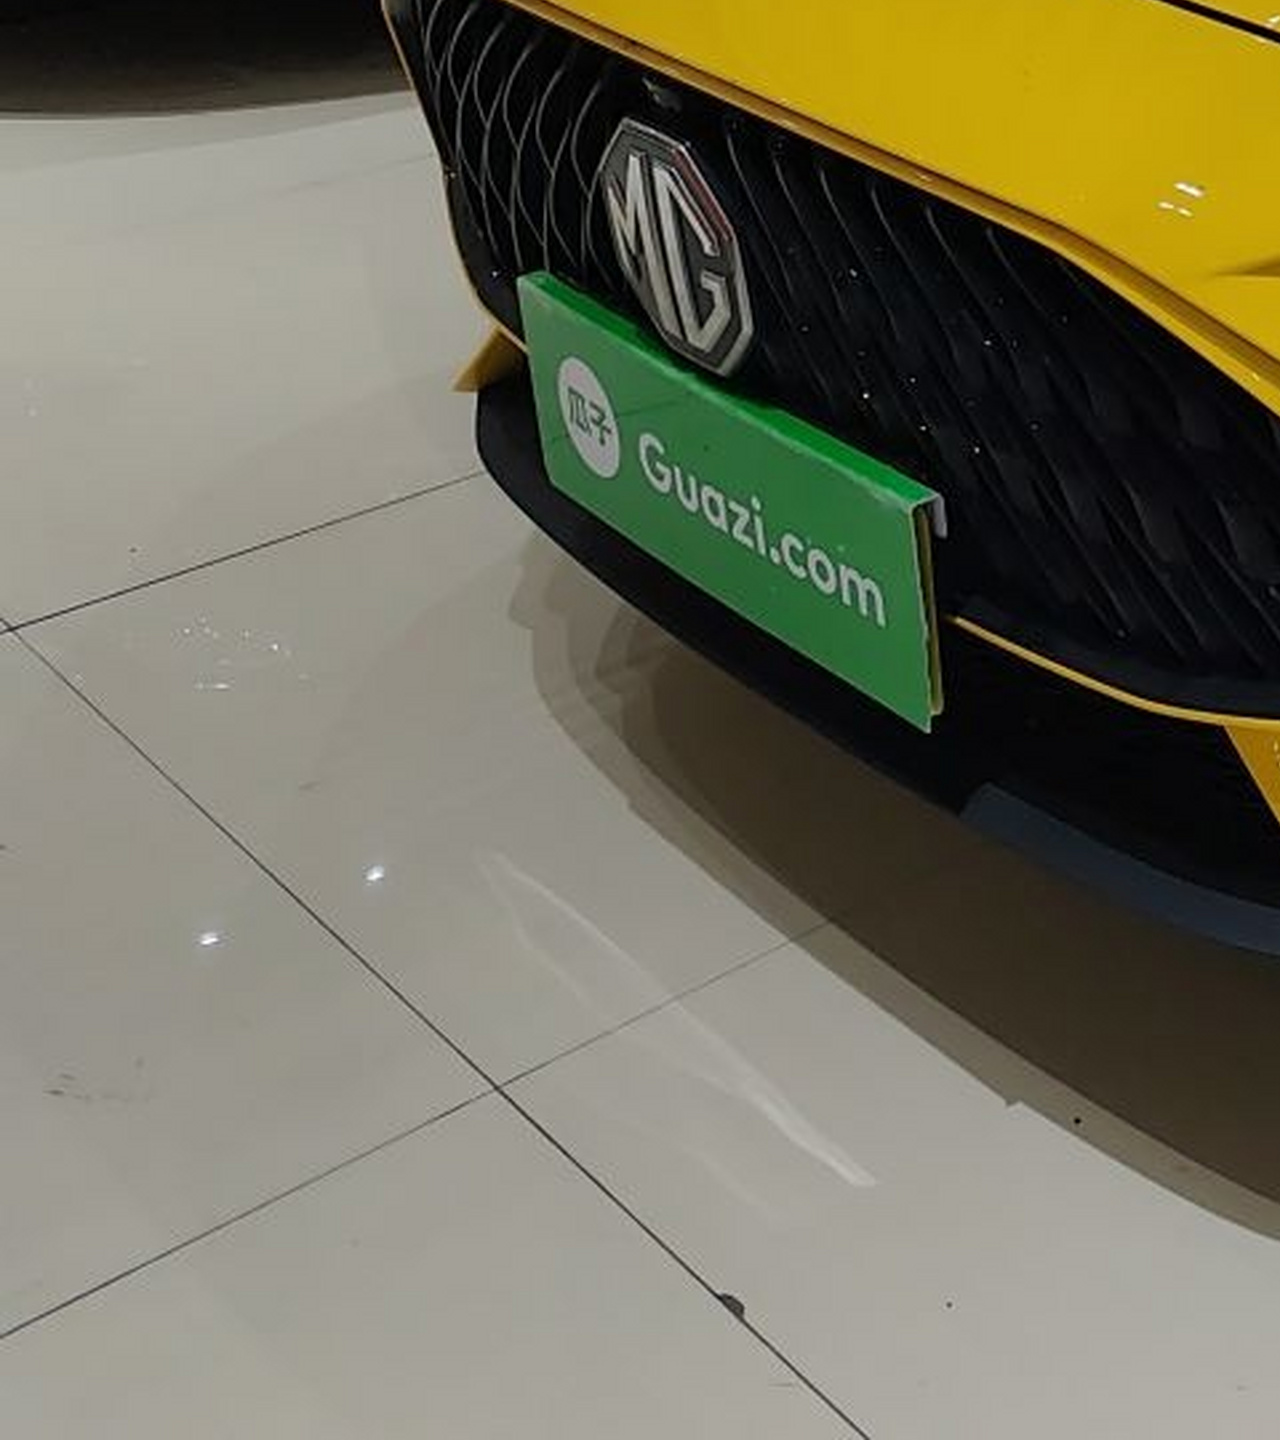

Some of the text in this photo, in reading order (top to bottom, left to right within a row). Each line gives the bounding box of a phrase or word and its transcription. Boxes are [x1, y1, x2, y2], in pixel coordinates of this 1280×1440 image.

[606, 150, 732, 354] MG
[567, 385, 613, 446] 瓜子
[638, 432, 887, 629] Guazi.com
